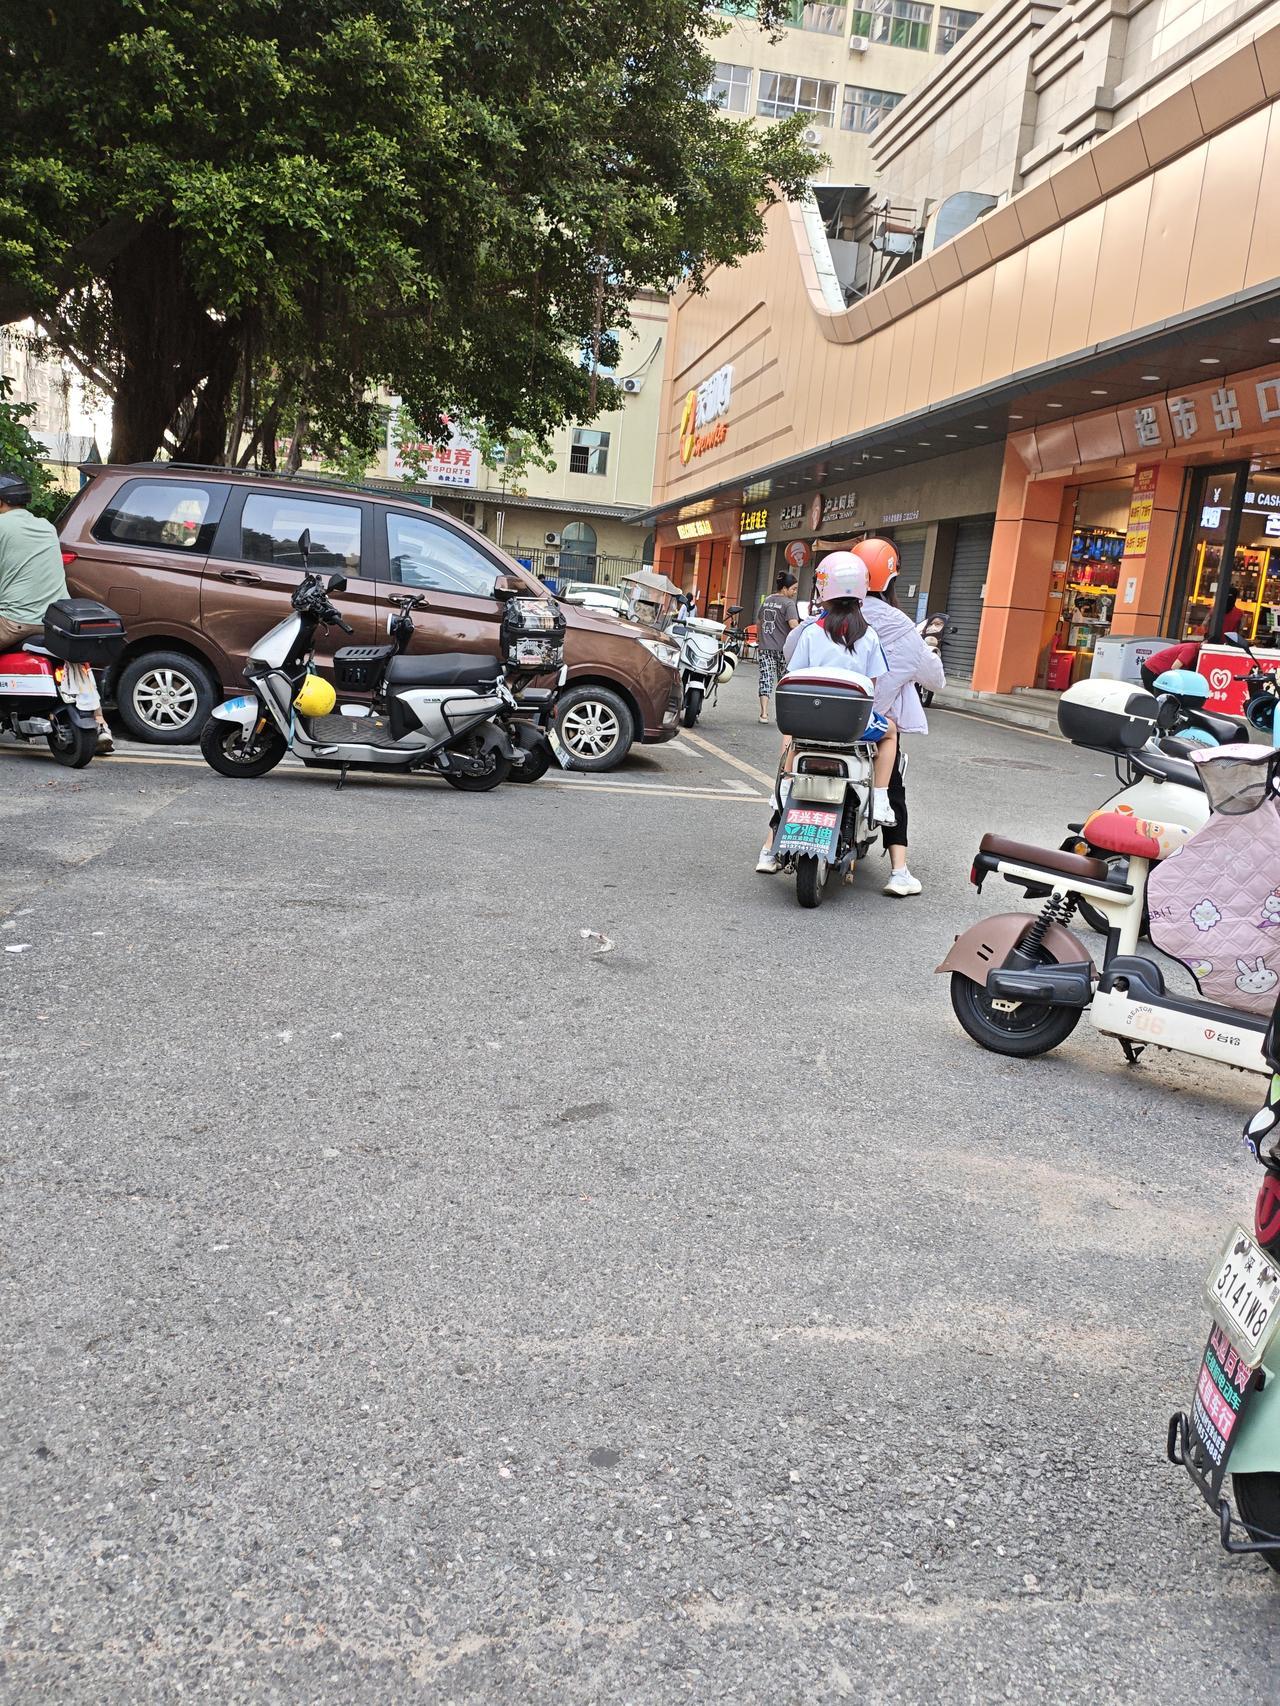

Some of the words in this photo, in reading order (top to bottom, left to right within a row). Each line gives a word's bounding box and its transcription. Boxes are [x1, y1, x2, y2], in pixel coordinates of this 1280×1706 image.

[1135, 377, 1280, 448] 超市出口
[427, 465, 471, 476] ESPORTS
[788, 810, 836, 828] 万兴车行
[800, 824, 833, 840] 雅迪
[1126, 1005, 1153, 1025] CREATOR
[1217, 1033, 1241, 1046] 台铃
[1217, 1263, 1268, 1337] 3141W8
